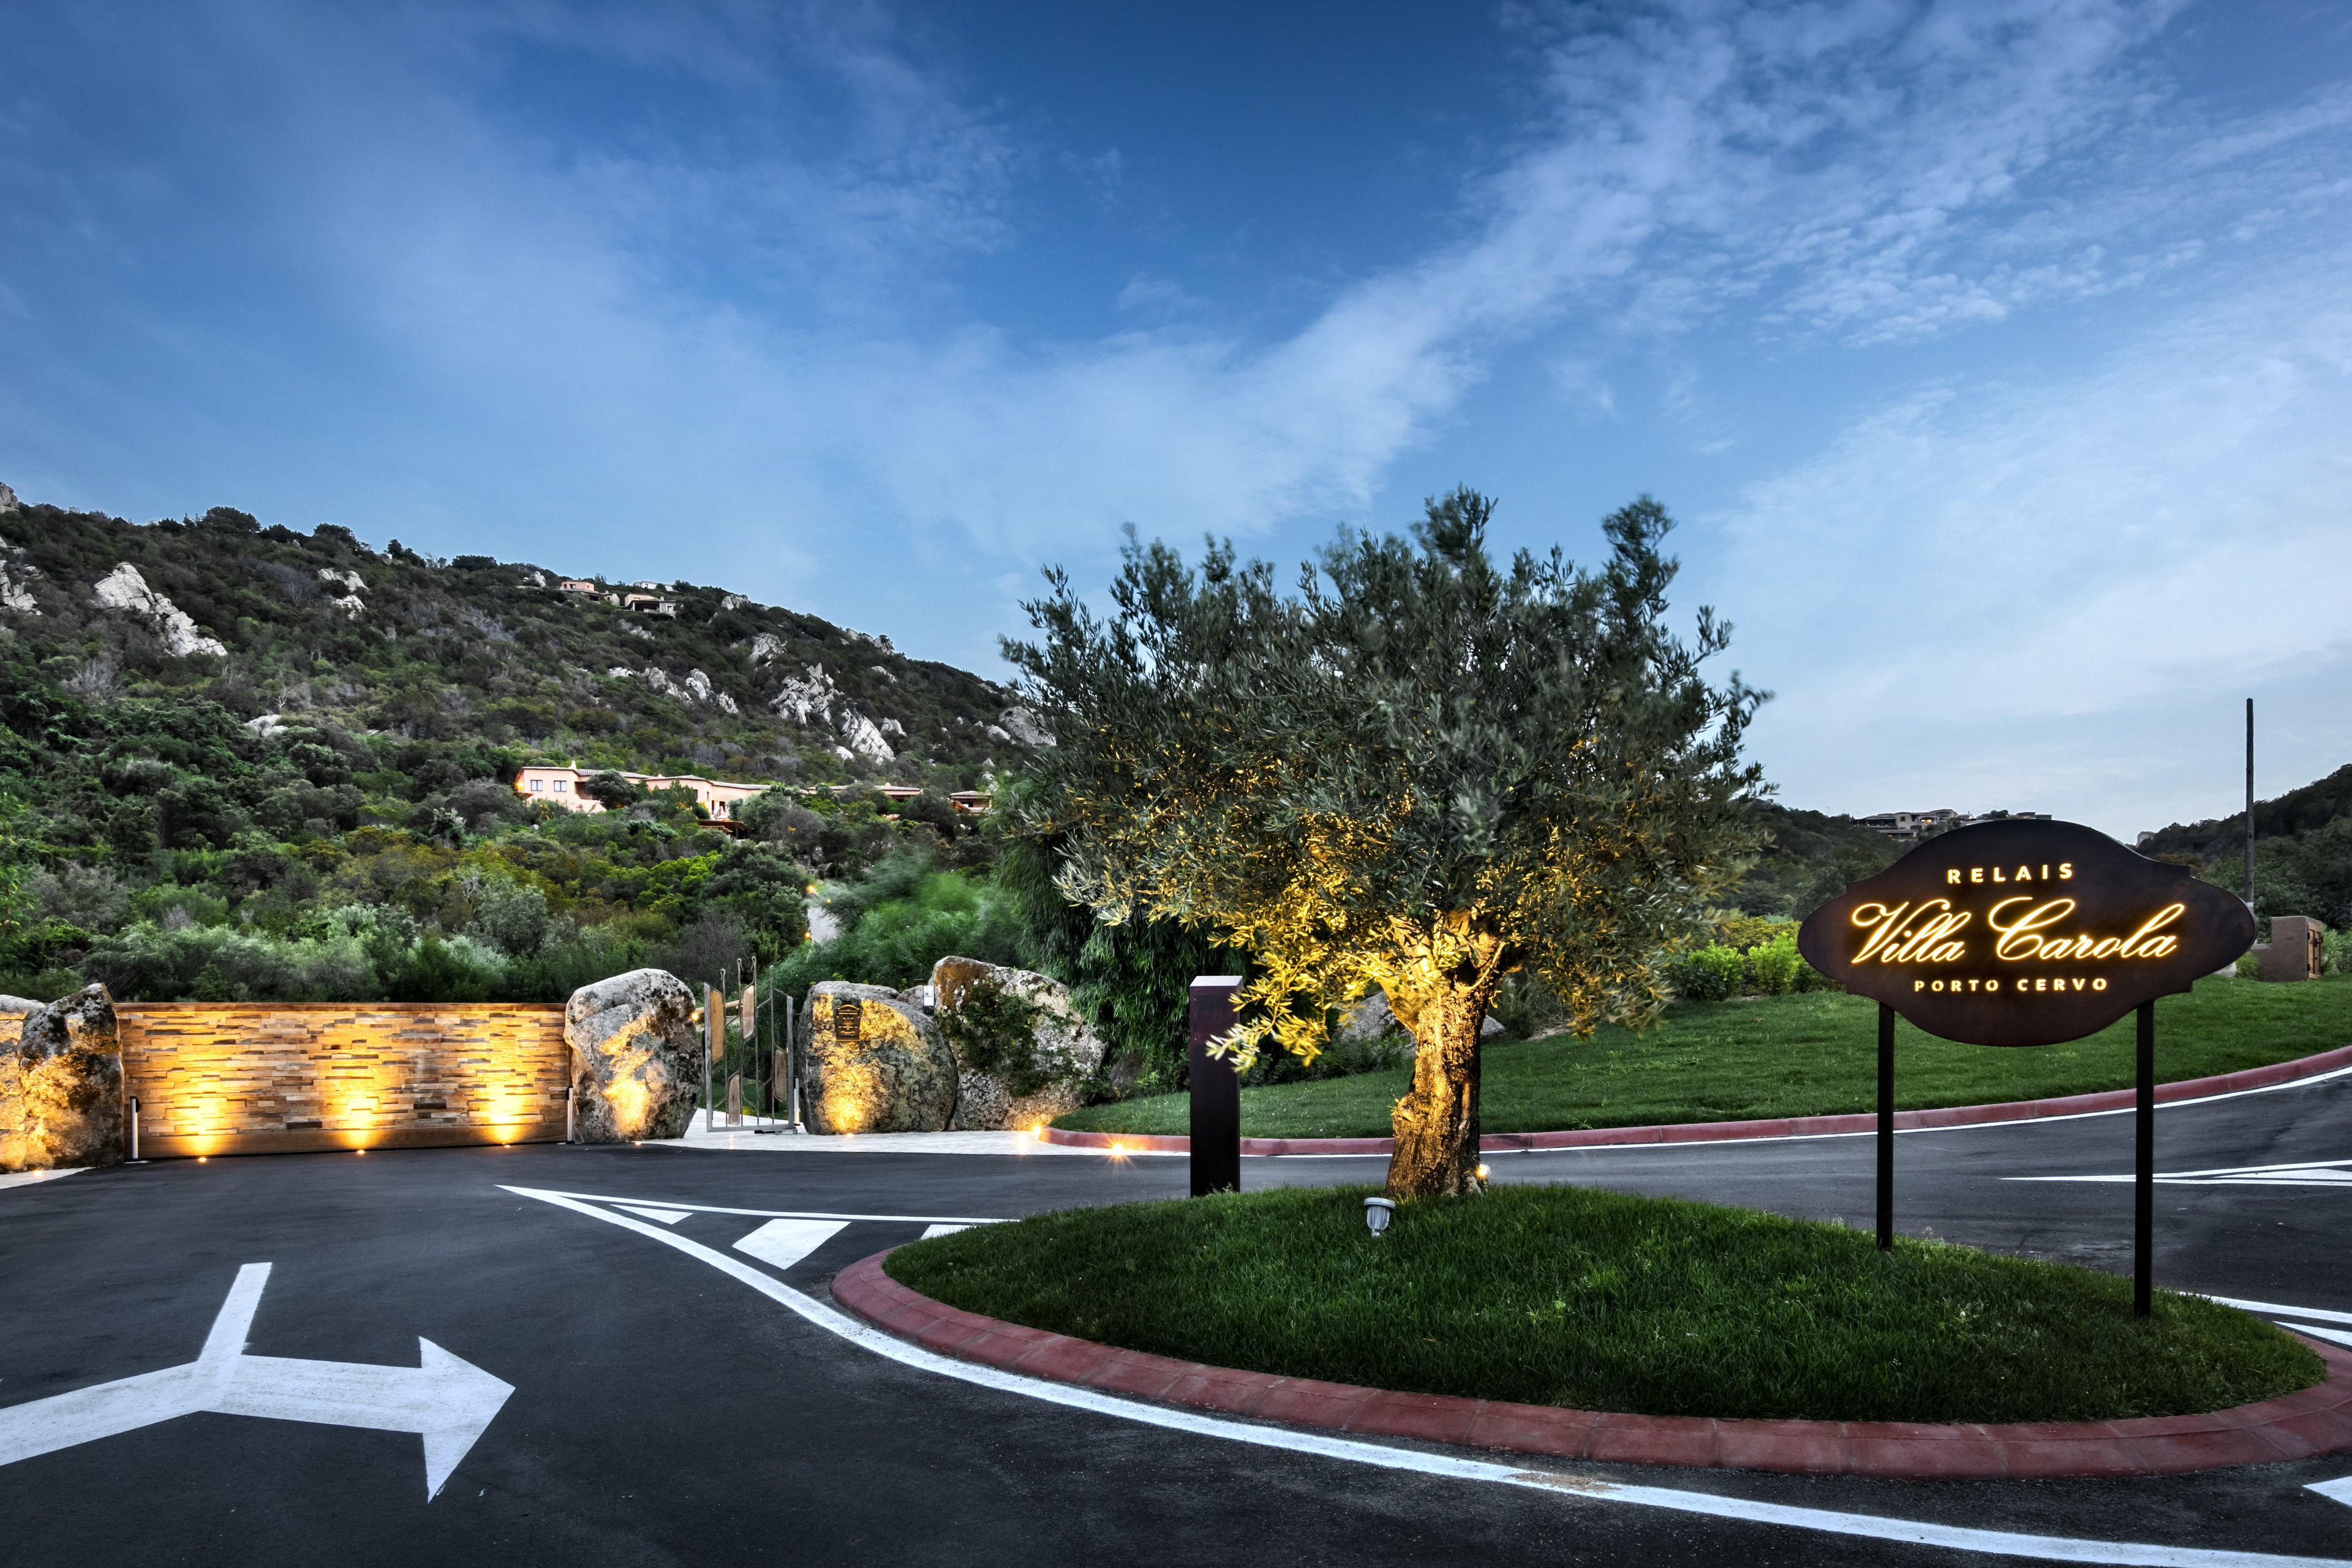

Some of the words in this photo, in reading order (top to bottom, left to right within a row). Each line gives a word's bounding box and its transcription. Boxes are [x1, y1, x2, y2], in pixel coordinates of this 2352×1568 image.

[1947, 863, 2073, 884] RELAIS
[1850, 898, 1972, 965] Villa
[1988, 896, 2185, 961] Carola
[1915, 979, 1999, 992] PORTO
[2017, 978, 2107, 992] CERVO
